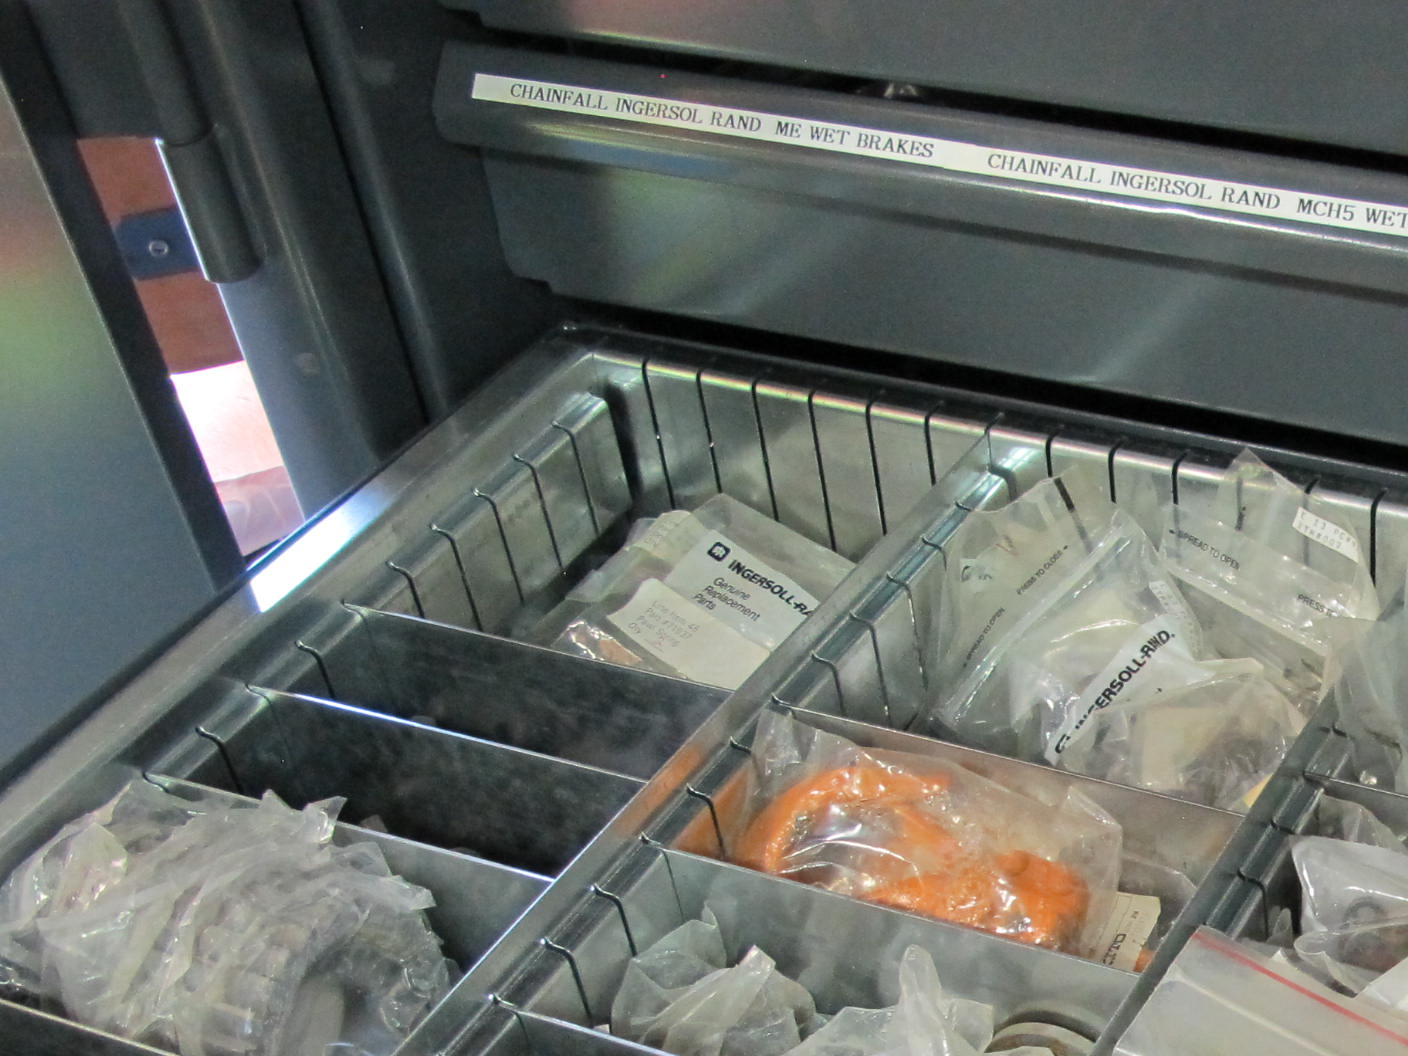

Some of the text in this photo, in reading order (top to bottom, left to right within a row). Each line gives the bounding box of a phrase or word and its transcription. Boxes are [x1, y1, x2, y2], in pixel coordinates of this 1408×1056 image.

[510, 82, 935, 158] CHAINFALL INGERSOL RAND ME WET BRAKES
[987, 153, 1101, 184] CHAINFALL
[1109, 169, 1212, 200] INGERSOL
[1221, 186, 1280, 210] RAND
[1296, 197, 1355, 222] MCH5
[693, 593, 717, 611] Parts
[704, 585, 761, 622] Replacement
[713, 576, 751, 601] Genuine
[1297, 594, 1326, 613] PRESS
